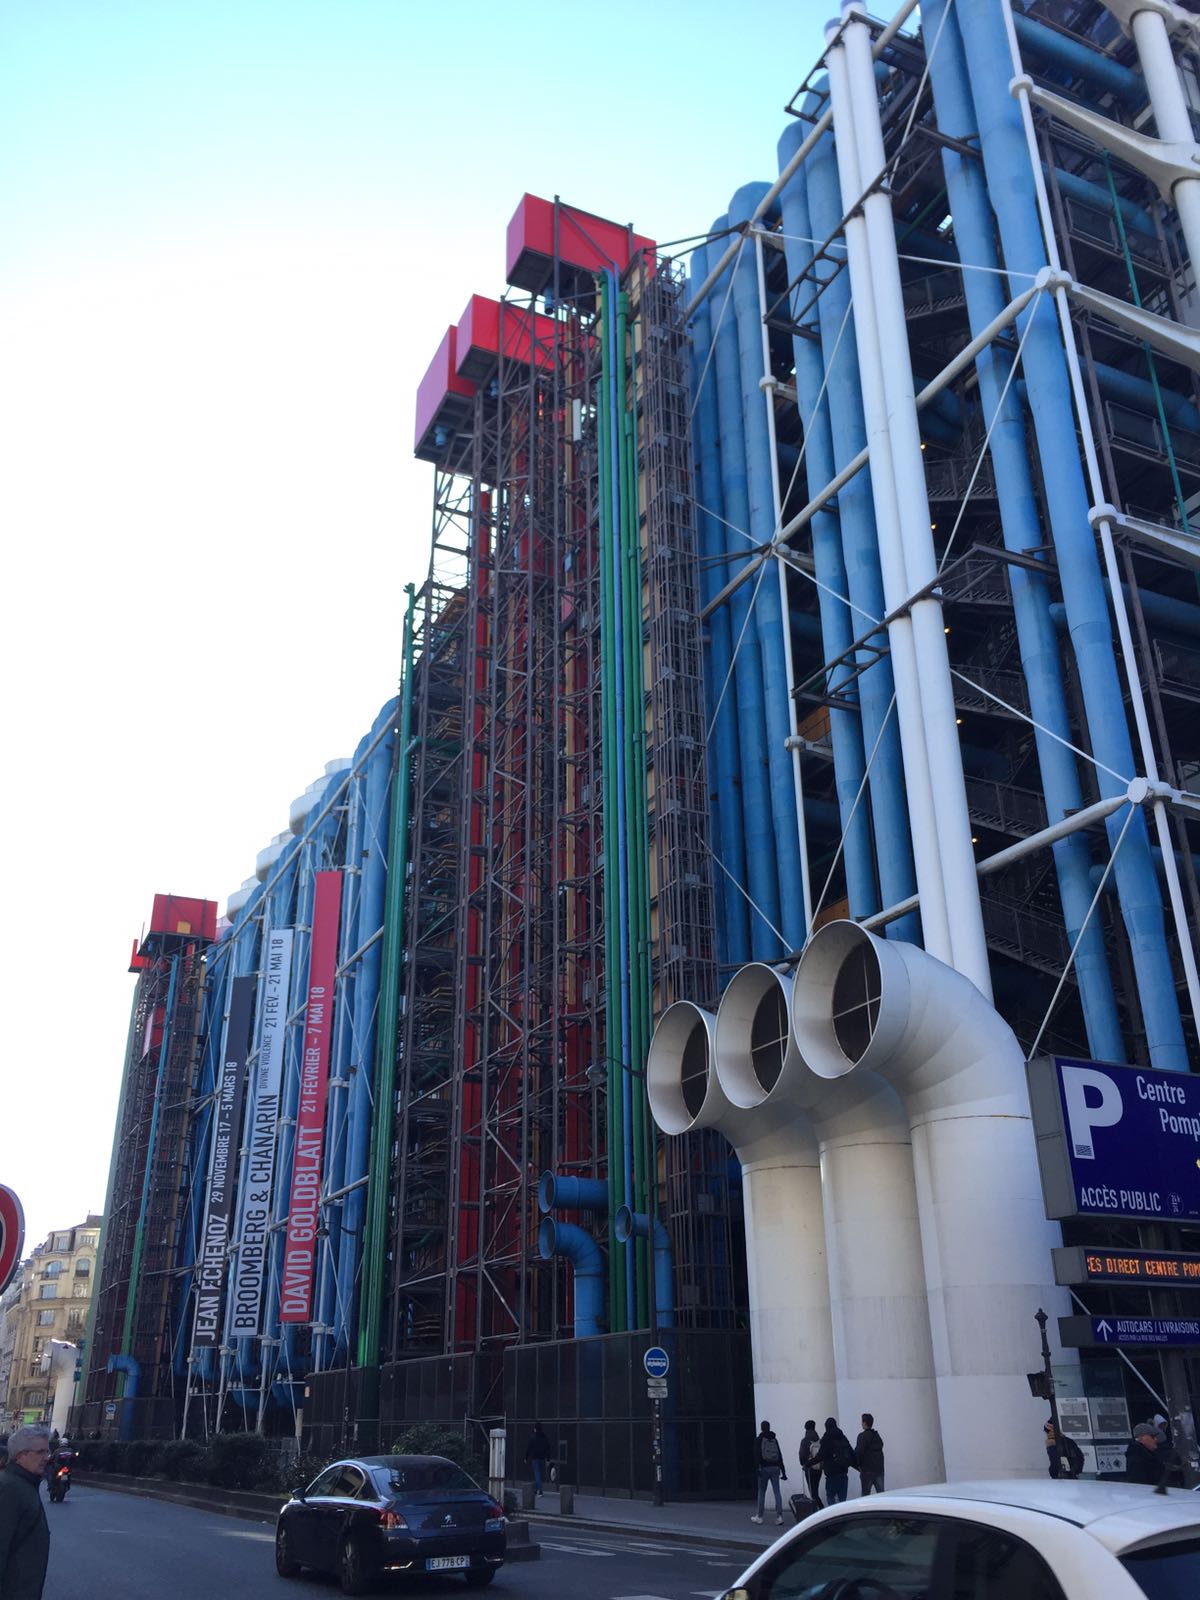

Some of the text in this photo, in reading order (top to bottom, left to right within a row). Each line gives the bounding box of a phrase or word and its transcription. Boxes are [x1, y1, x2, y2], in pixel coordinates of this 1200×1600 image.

[272, 938, 284, 949] 18
[270, 953, 283, 971] MAI
[269, 974, 281, 985] 21
[311, 986, 325, 999] 18
[265, 1017, 278, 1028] 21
[309, 1003, 324, 1024] MAI
[226, 1061, 238, 1072] 18
[260, 1034, 273, 1089] DIVINE VIOLENCE
[223, 1075, 236, 1102] MARS
[1136, 1075, 1187, 1105] Centre
[302, 1099, 317, 1113] 21
[1061, 1065, 1124, 1160] P
[219, 1121, 232, 1133] 17
[1159, 1107, 1200, 1142] Pomp
[213, 1135, 230, 1188] NOVEMBRE
[290, 1125, 322, 1243] GOLDBLATT
[211, 1190, 224, 1203] 29
[1081, 1184, 1118, 1209] ACCÈS
[1120, 1189, 1162, 1212] PUBLIC
[235, 1094, 278, 1329] BROOMBERG & CHANARIN
[202, 1213, 229, 1290] ECHENOZ
[1106, 1258, 1141, 1275] DIRECT
[1145, 1260, 1180, 1277] CENTRE
[284, 1250, 311, 1314] DAVID
[196, 1296, 220, 1341] JEAN
[1117, 1320, 1153, 1334] AUTOCARS
[1159, 1321, 1200, 1335] LIVRAISONS
